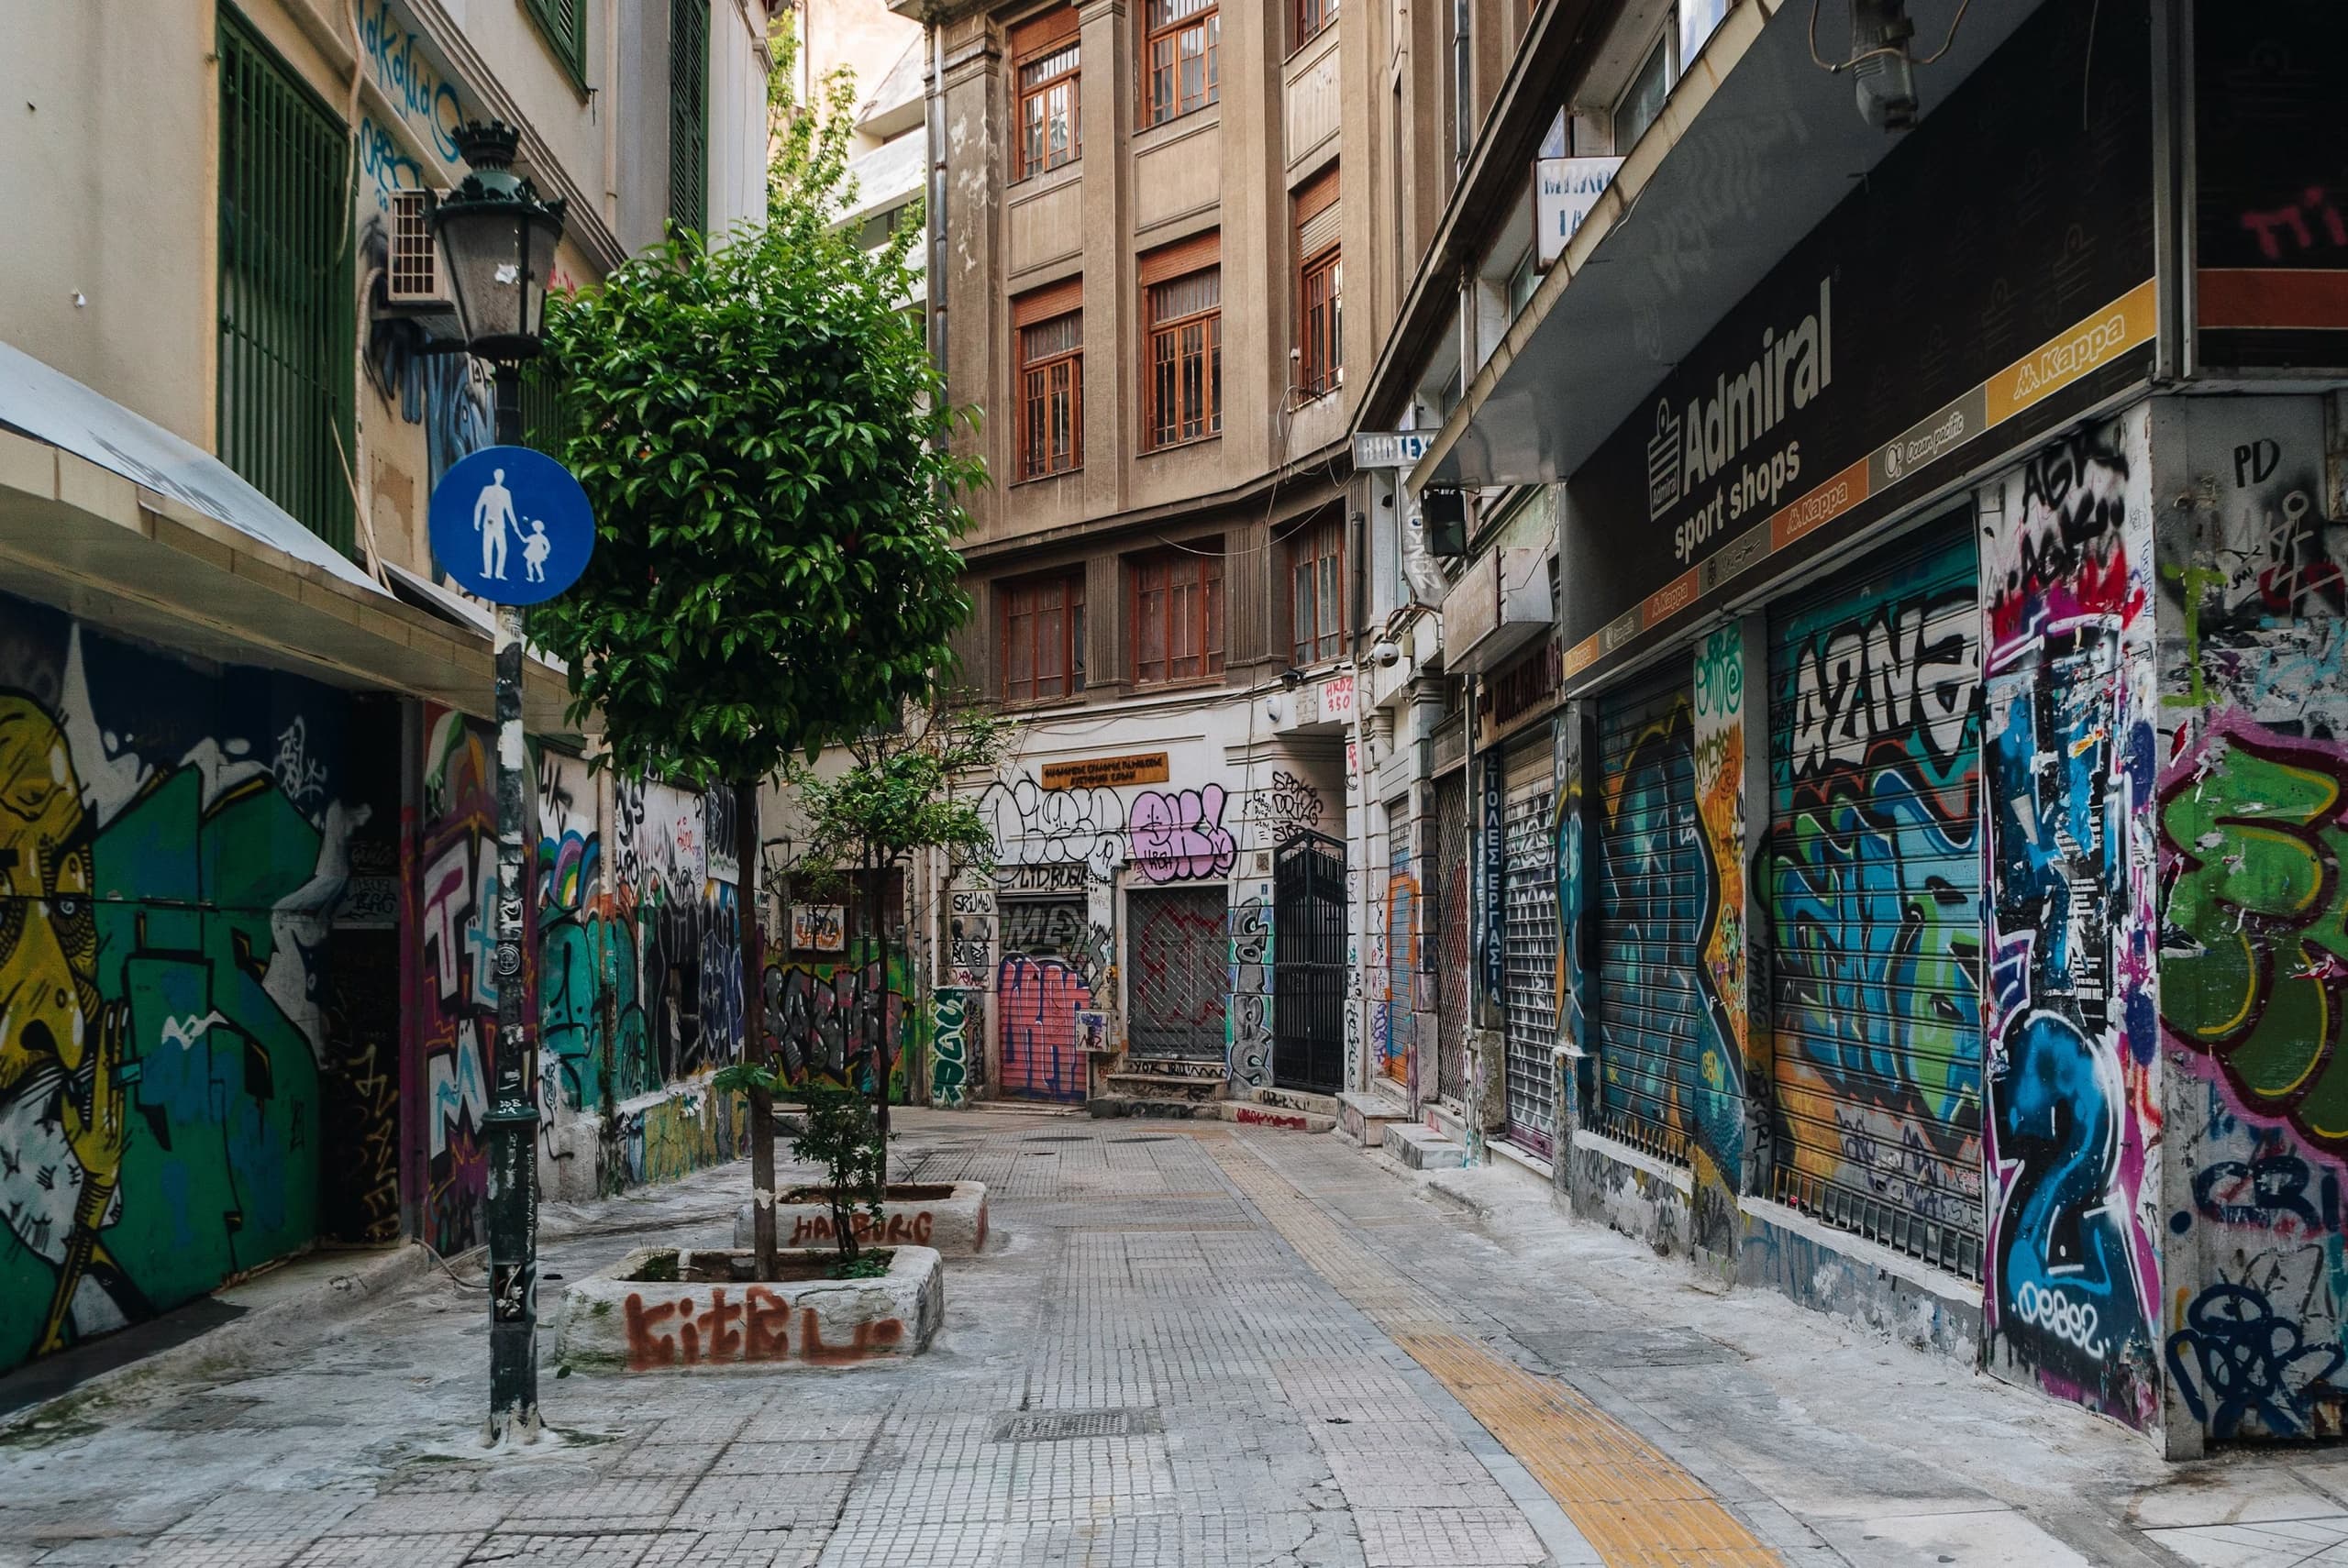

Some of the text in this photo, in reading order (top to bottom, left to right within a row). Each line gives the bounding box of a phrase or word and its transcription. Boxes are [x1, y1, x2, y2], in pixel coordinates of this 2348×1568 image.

[2039, 314, 2125, 383] Kappa
[1683, 276, 1832, 496] Admiral
[1907, 411, 1965, 465] Ocean pacific
[2233, 438, 2281, 489] PD
[1652, 475, 1678, 504] Admiral
[1675, 485, 1724, 564] sport
[1730, 440, 1800, 520] shops
[1801, 481, 1847, 525] Kappa
